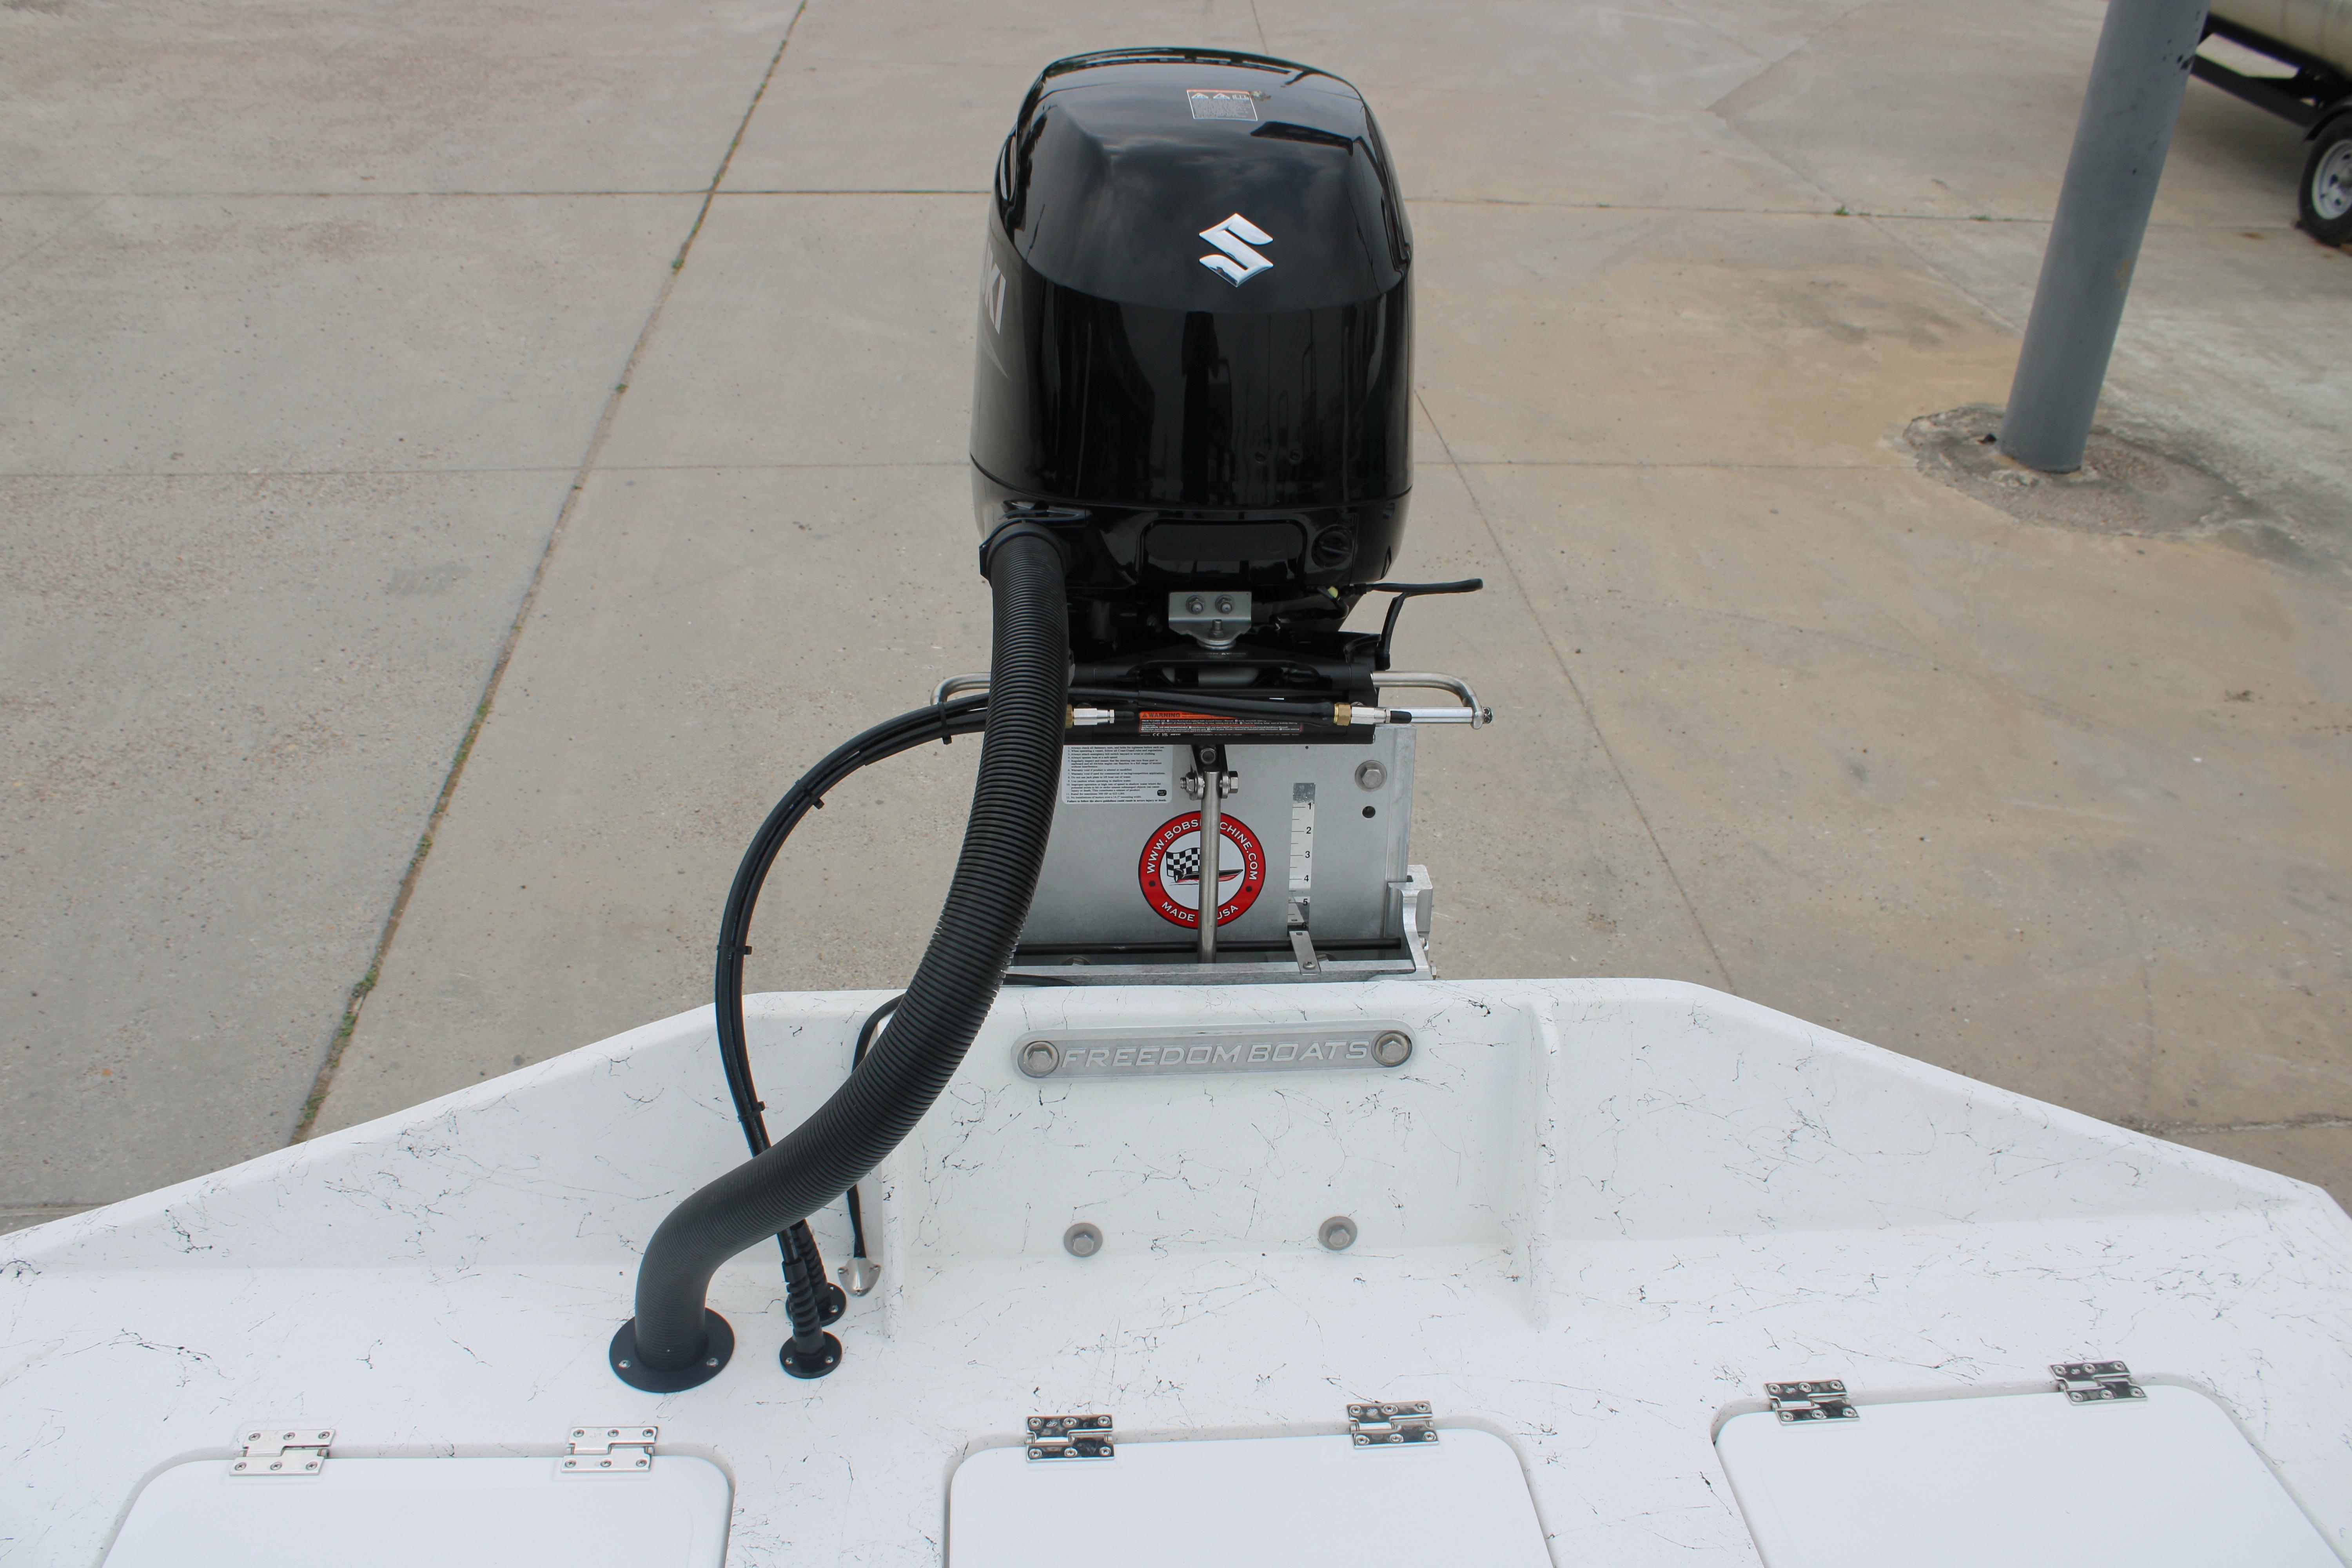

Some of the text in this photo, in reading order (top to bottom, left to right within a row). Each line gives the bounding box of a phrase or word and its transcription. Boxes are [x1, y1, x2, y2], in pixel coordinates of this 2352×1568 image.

[1147, 819, 1258, 880] WWW.BOBSCHINE.COM
[1161, 901, 1195, 922] MADE
[1062, 1040, 1370, 1068] FREEDOM BOATS
